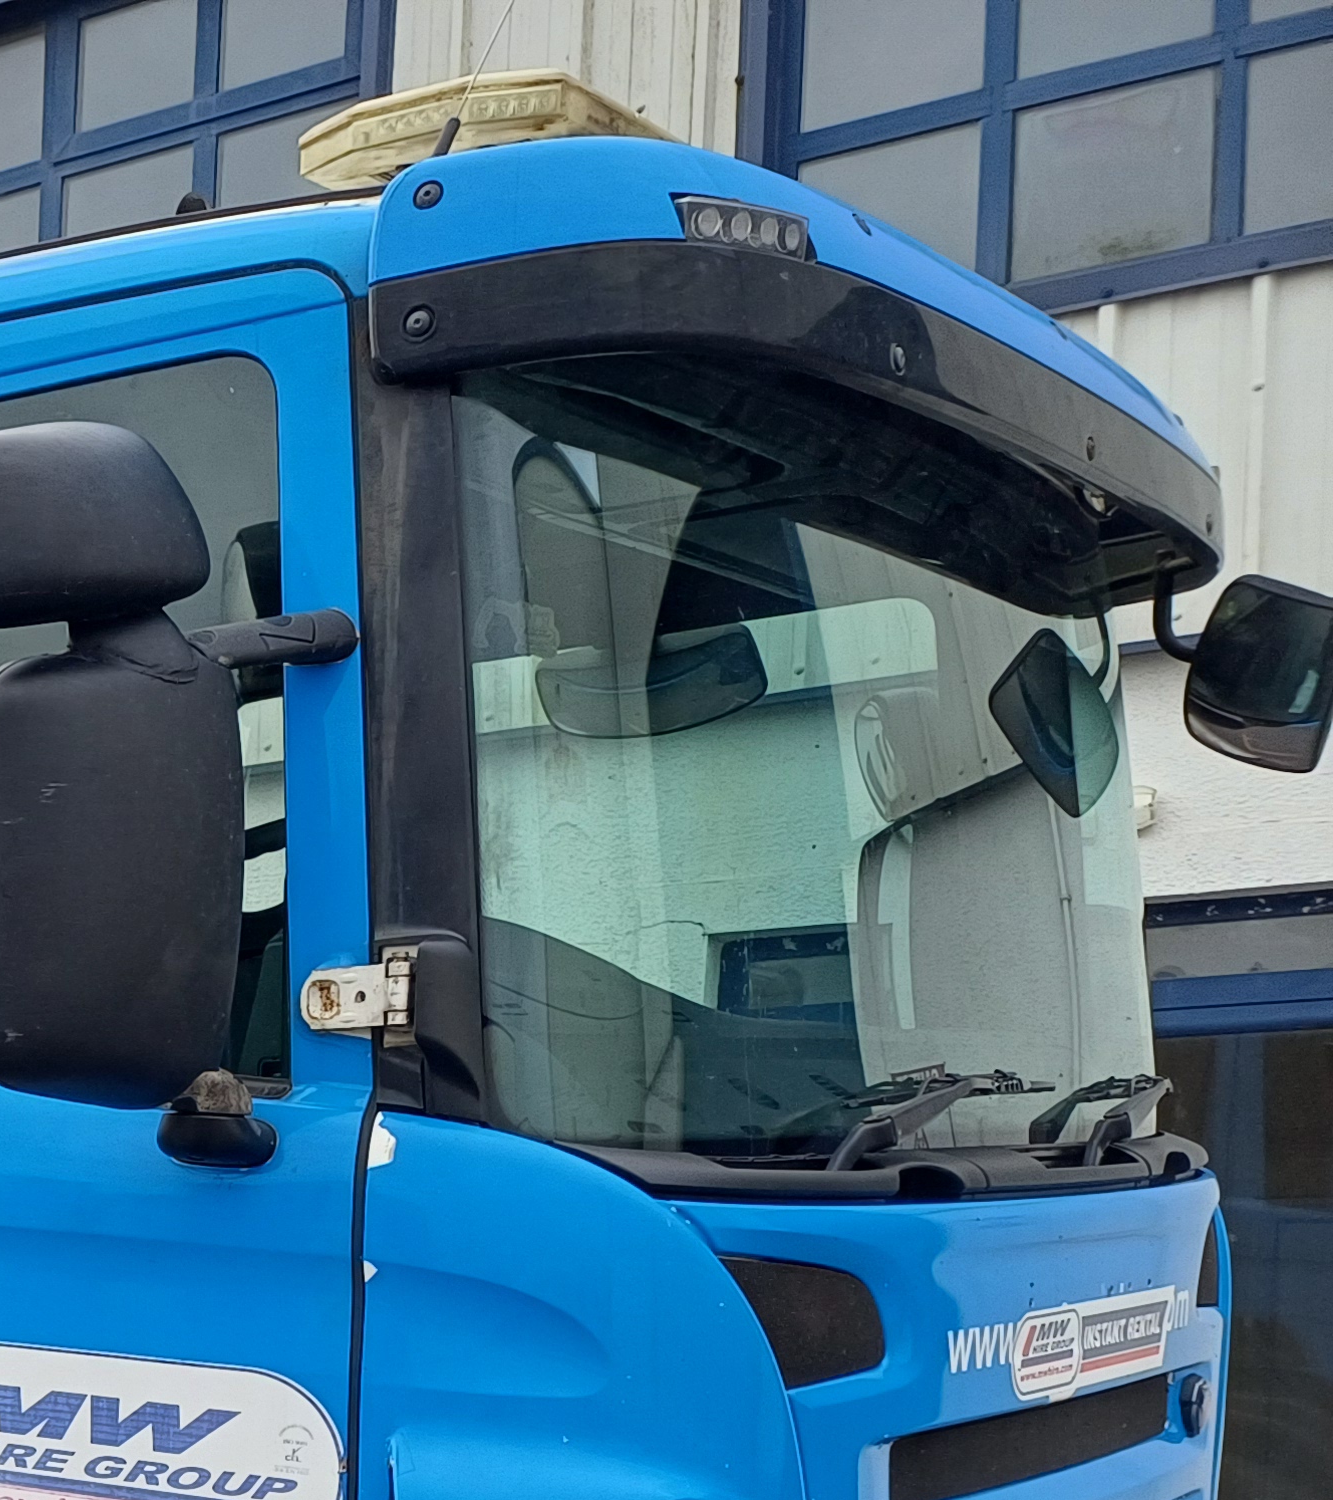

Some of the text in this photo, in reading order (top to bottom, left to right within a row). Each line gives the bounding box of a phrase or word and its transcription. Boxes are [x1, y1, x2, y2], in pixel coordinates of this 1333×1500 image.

[1036, 1318, 1071, 1341] MW
[1083, 1312, 1161, 1350] INSTANT RENTAL
[1032, 1337, 1075, 1354] HIRE GROUP
[83, 1455, 298, 1500] GROUP
